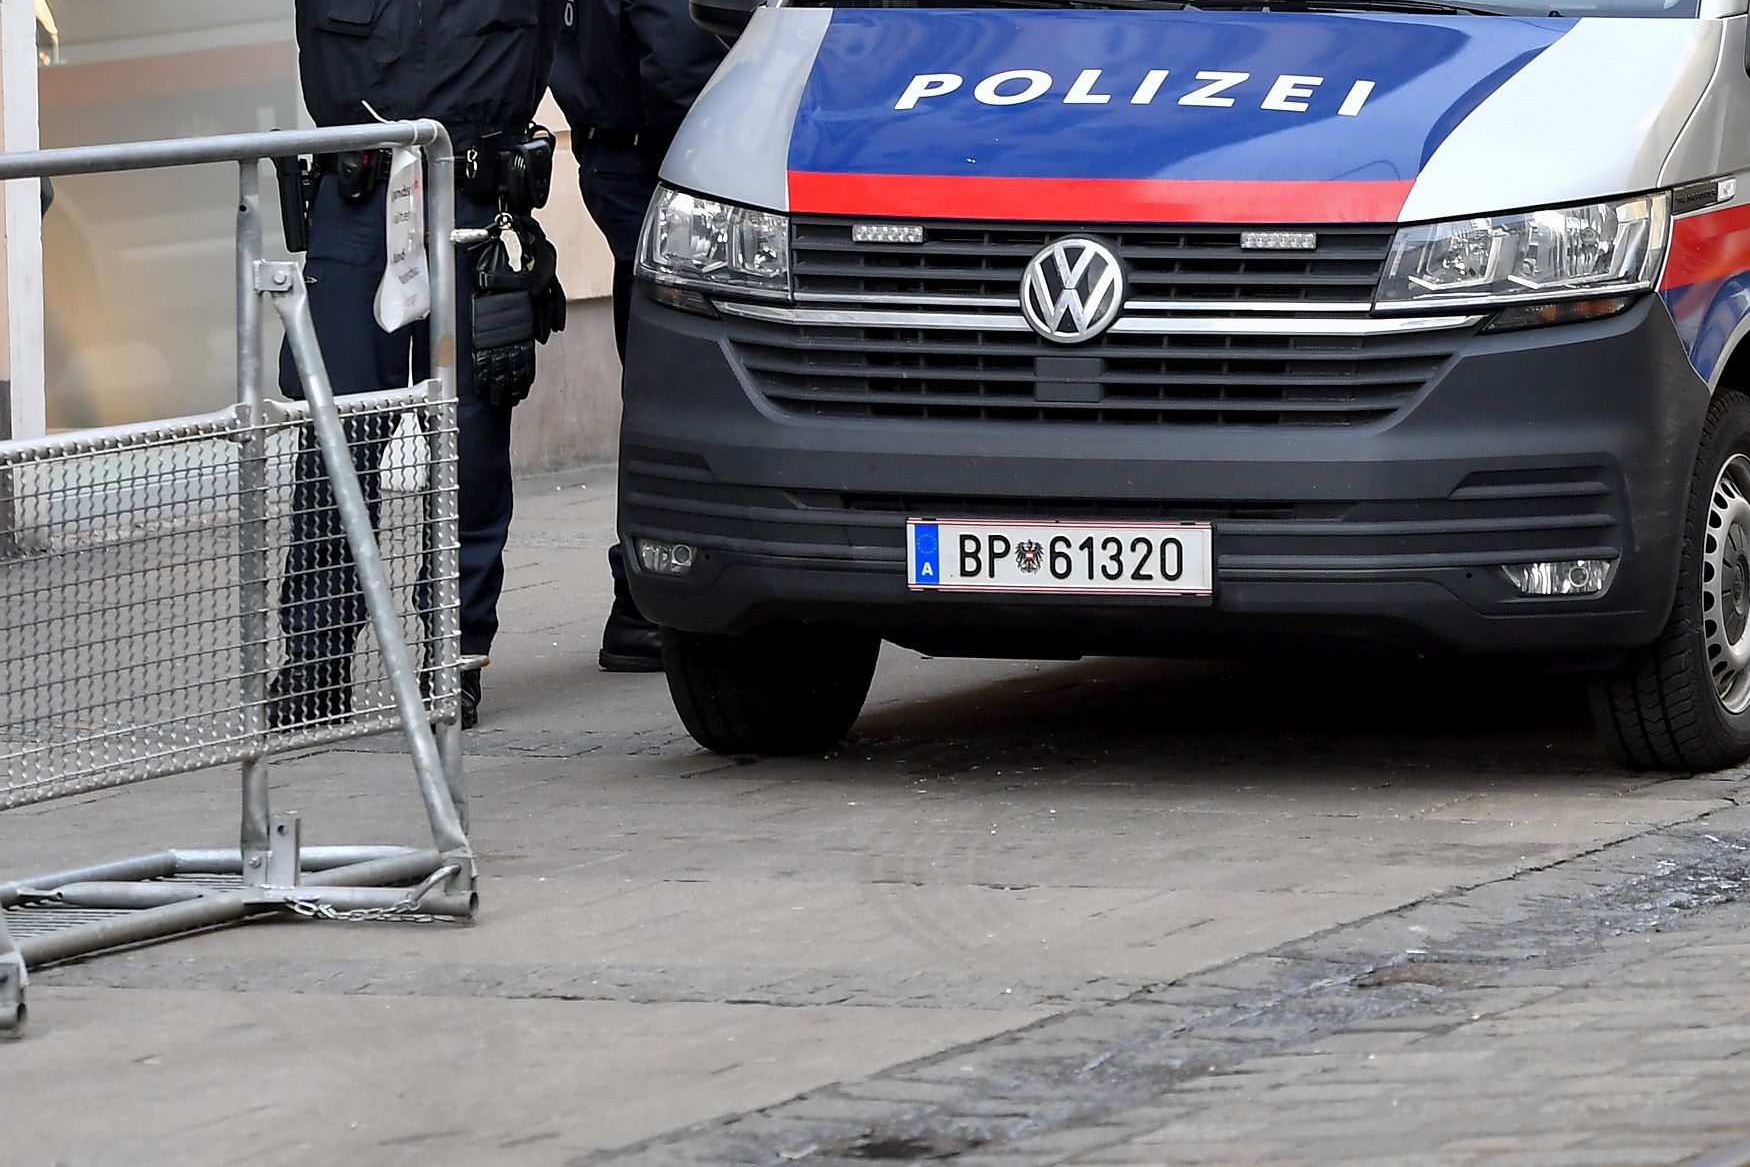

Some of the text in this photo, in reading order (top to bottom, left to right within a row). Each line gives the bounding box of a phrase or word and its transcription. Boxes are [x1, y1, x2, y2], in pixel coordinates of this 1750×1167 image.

[894, 68, 1377, 117] POLIZEI
[920, 561, 934, 577] A
[958, 533, 1184, 581] BP 61320
